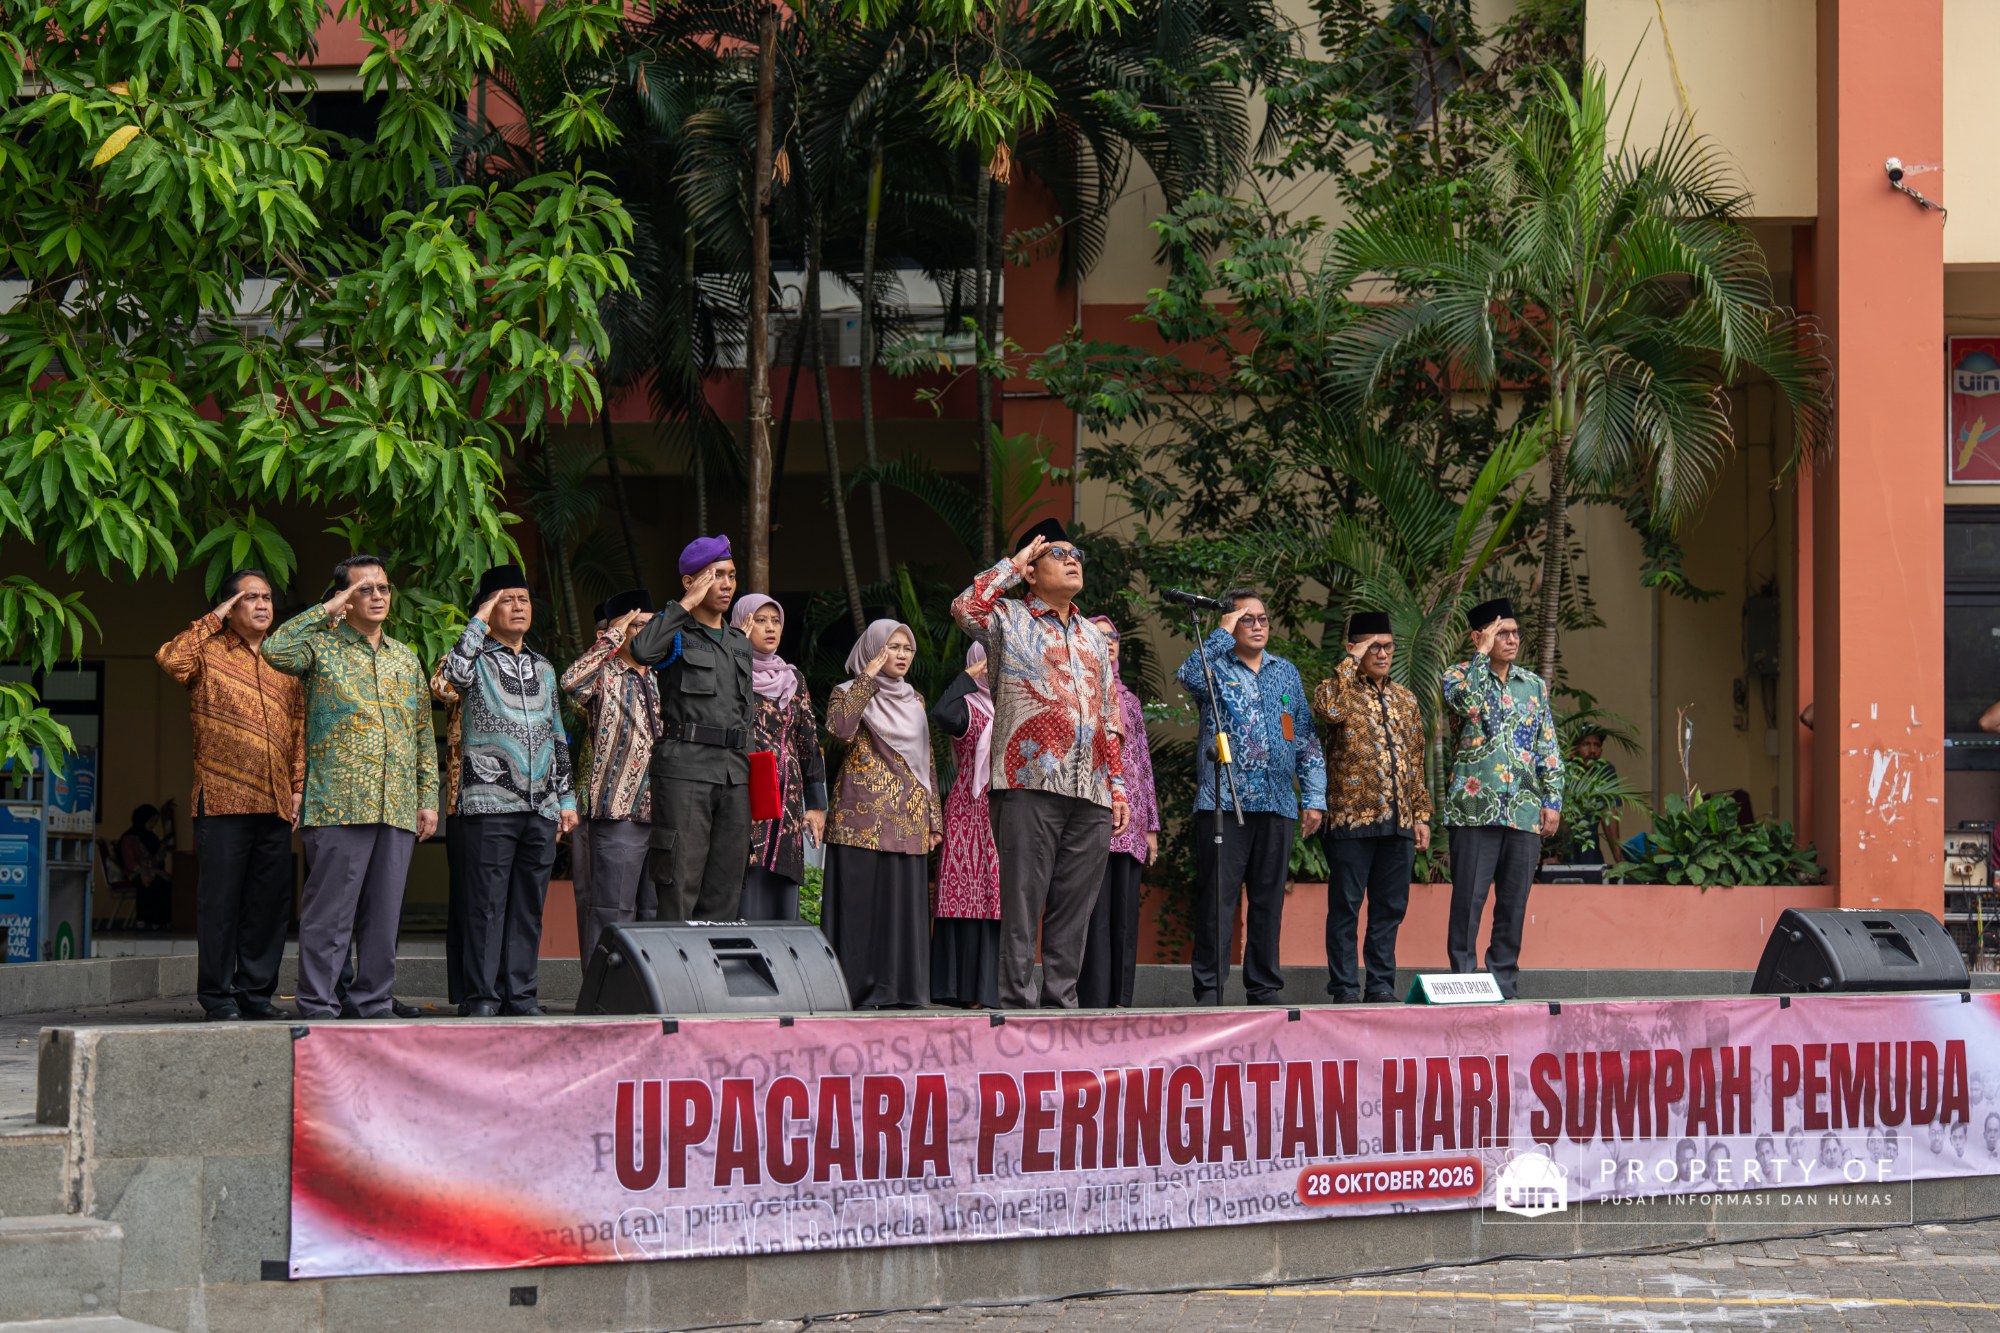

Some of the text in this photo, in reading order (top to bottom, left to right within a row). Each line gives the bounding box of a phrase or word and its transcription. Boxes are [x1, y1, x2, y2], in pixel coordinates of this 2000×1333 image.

[995, 1015, 1188, 1058] CONGRES
[613, 1073, 952, 1191] UPACARA
[977, 1058, 1359, 1177] PERINGATAN
[1382, 1054, 1511, 1156] HARI
[1529, 1045, 1752, 1145] SUMPAH
[1771, 1039, 1970, 1132] PEMUDA
[1307, 1166, 1474, 1196] 28 OKTOBER 2026
